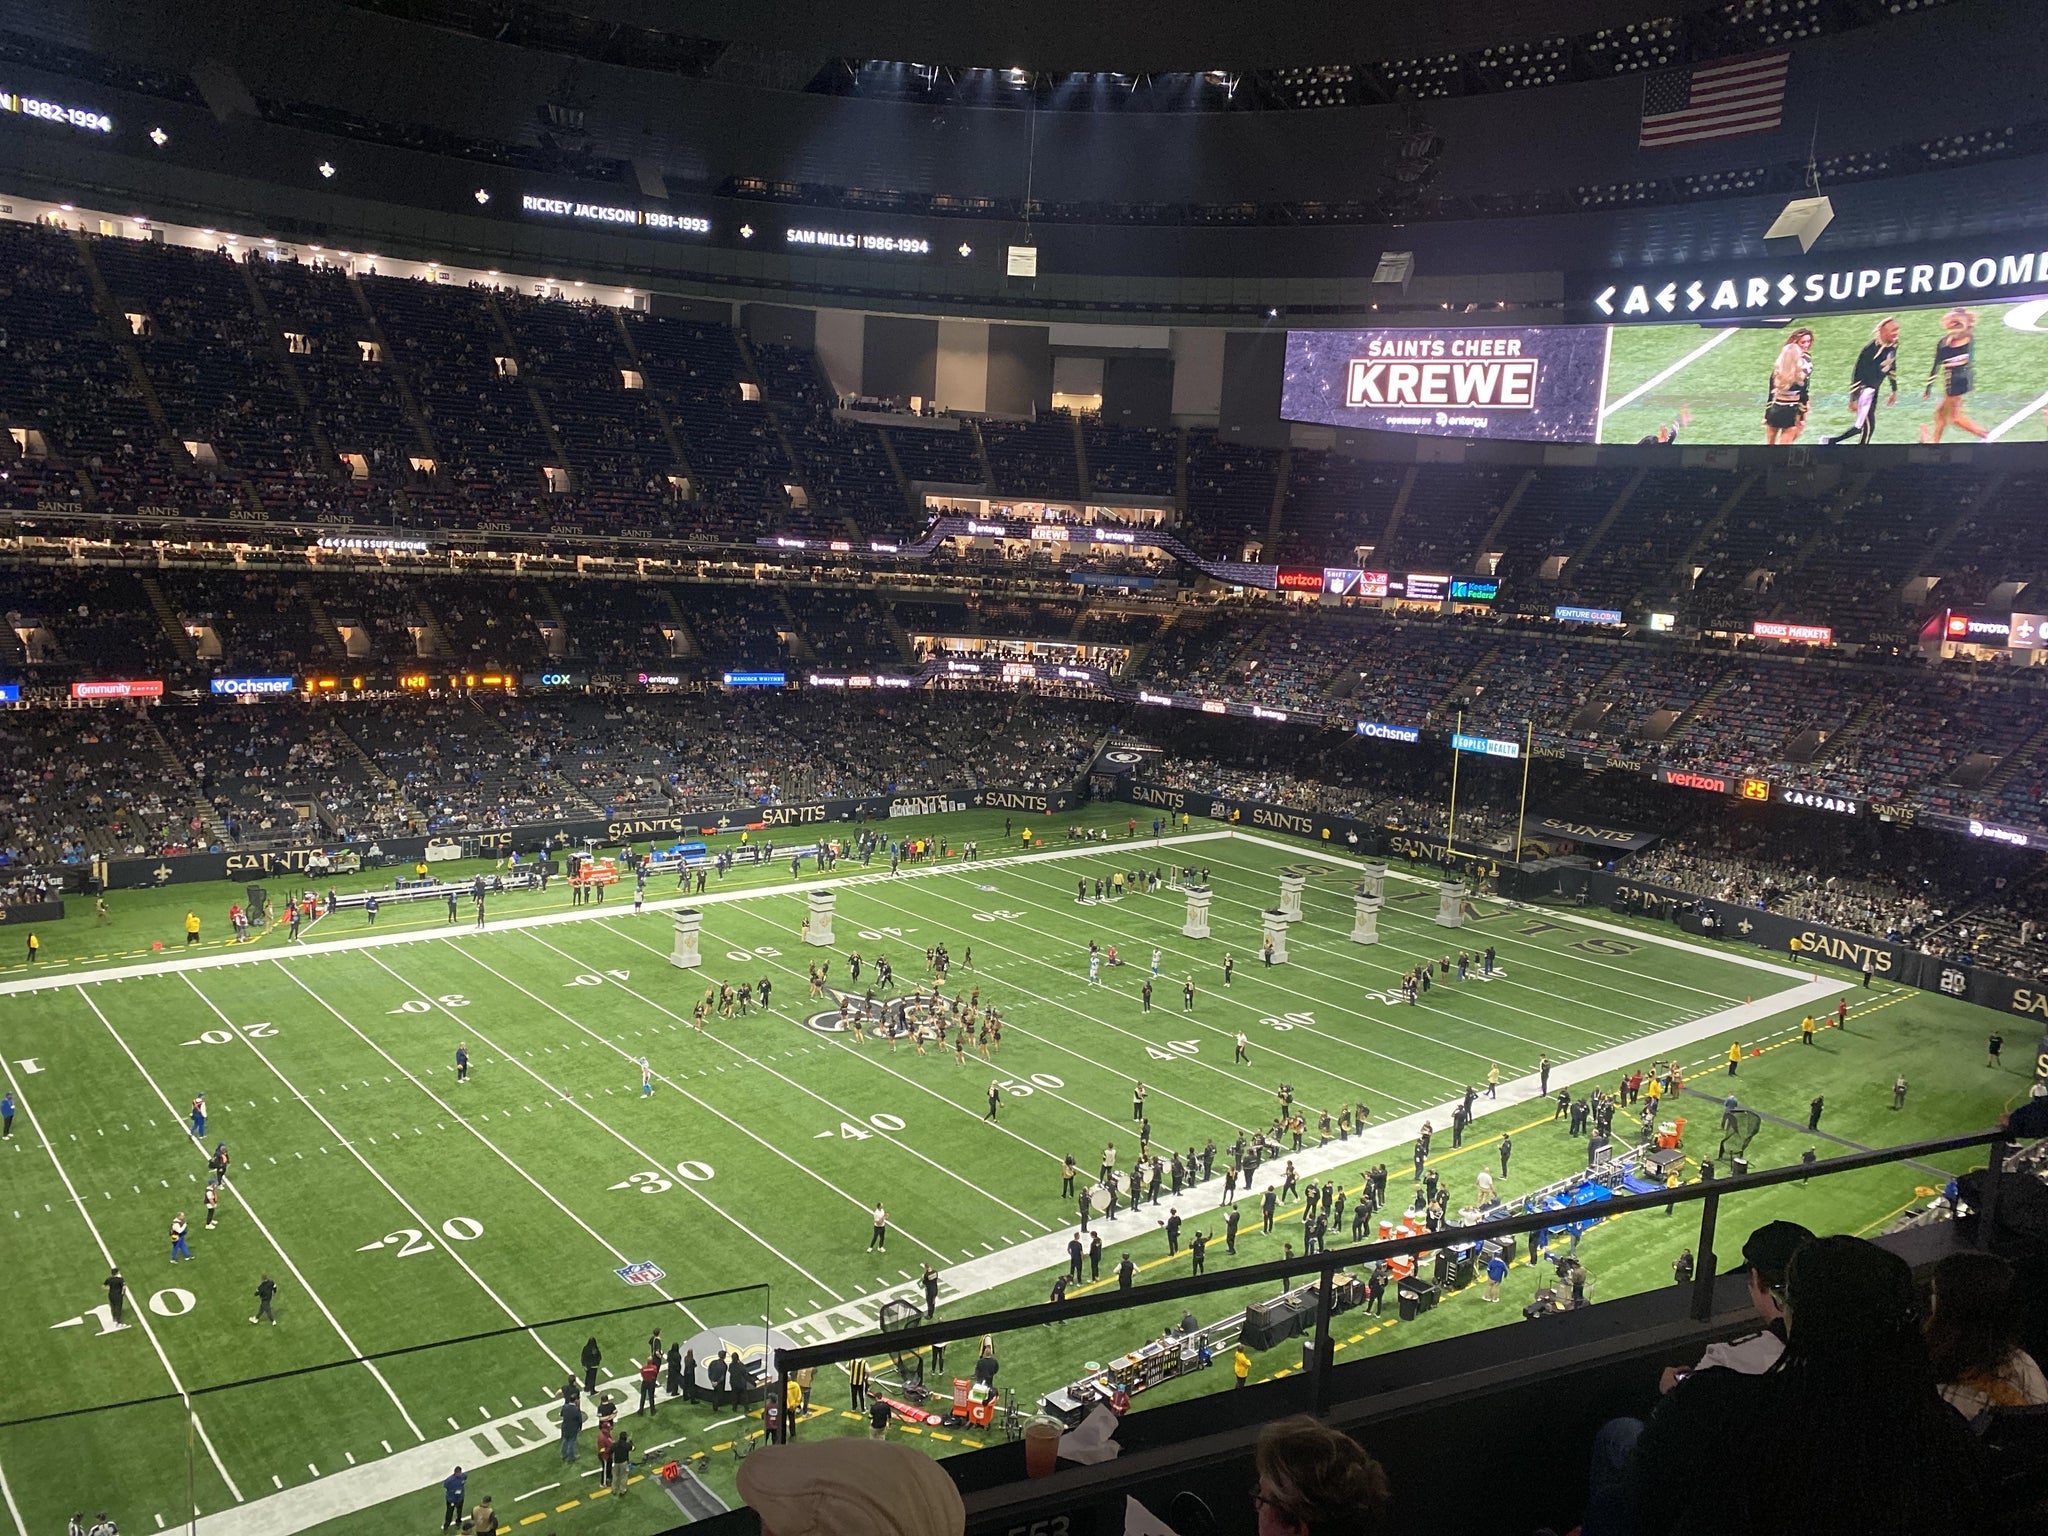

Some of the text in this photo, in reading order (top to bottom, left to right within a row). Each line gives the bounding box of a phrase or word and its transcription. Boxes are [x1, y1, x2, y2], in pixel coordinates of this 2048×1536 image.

[20, 97, 112, 133] 1982-1994
[523, 195, 709, 233] RICKEY JACKSON 1981-1993
[787, 229, 929, 254] SAM MILLS 1986-1994
[1594, 250, 2048, 316] CAESARS SUPERDOME
[1368, 339, 1521, 357] SAINTS CHEER
[1350, 363, 1533, 404] KREWE
[1448, 415, 1488, 428] entergy
[37, 501, 83, 513] SAINTS
[137, 506, 180, 517] SAINTS
[229, 511, 269, 521] SAINTS
[317, 514, 354, 525] SAINTS
[477, 522, 512, 532] SAINTS
[551, 526, 583, 535] SAINTS
[621, 529, 652, 538] SAINTS
[976, 525, 1005, 537] entergy
[689, 534, 720, 543] SAINTS
[1031, 529, 1069, 541] KREWE
[316, 537, 427, 550] CAESARS SUPERDOME
[1279, 574, 1322, 587] verizon
[1519, 603, 1549, 613] SAINTS
[1557, 609, 1620, 621] VENTURE GLOBAL
[1755, 625, 1828, 640] ROUSES MARKETS
[1968, 622, 2010, 635] TOYOTA
[1002, 666, 1036, 677] KREWE
[224, 680, 290, 694] Ochsner
[542, 675, 571, 685] COX
[648, 676, 679, 685] entergy
[77, 683, 132, 697] Community
[1326, 716, 1354, 727] SAINTS
[1366, 724, 1418, 743] Ochsner
[1488, 741, 1518, 757] HEALTH
[1533, 747, 1566, 760] SAINTS
[1606, 758, 1641, 771] SAINTS
[1666, 770, 1725, 793] verizon
[1132, 786, 1184, 808] SAINTS
[1746, 782, 1767, 799] 25
[985, 792, 1048, 811] SAINTS
[1784, 790, 1857, 815] CAESARS
[762, 805, 826, 825] SAINTS
[1872, 803, 1915, 820] SAINTS
[1253, 809, 1313, 833] SAINTS
[608, 817, 682, 842] SAINTS
[1541, 818, 1636, 843] SAINTS
[725, 946, 784, 963] 50
[1800, 931, 1893, 972] SAINTS
[574, 968, 632, 987] 40
[200, 1021, 280, 1047] 20
[998, 1072, 1065, 1098] 50
[840, 1113, 907, 1141] 40
[629, 1160, 715, 1194] 30
[383, 1216, 484, 1258] 20
[627, 1268, 663, 1285] NFL
[972, 1406, 985, 1420] G
[665, 1466, 679, 1480] 20
